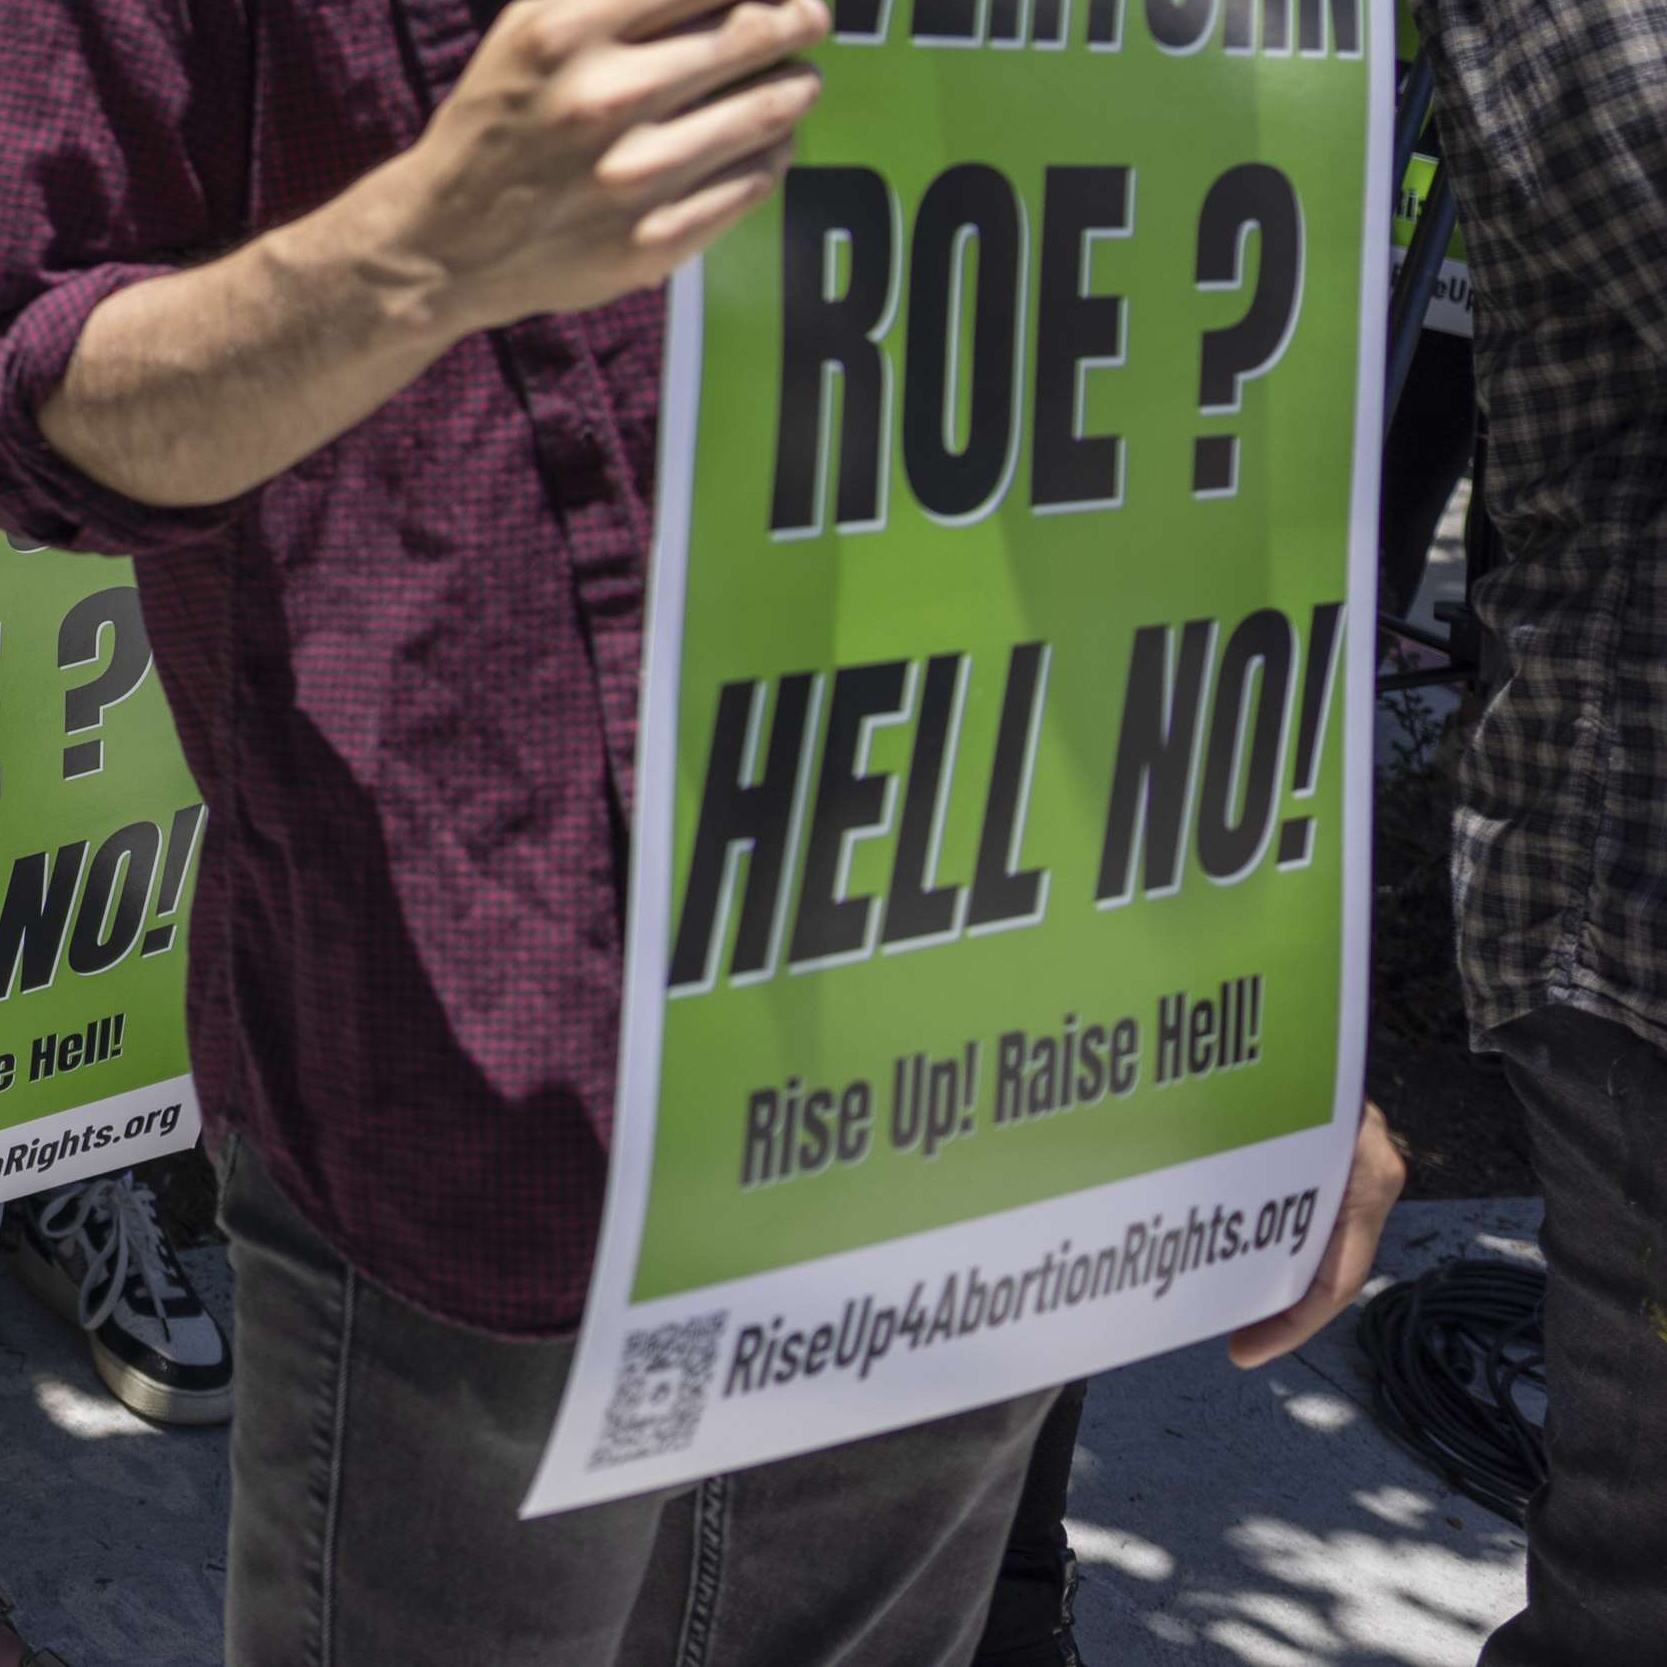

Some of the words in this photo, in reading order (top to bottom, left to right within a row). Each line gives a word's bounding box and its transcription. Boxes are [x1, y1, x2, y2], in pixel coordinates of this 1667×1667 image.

[767, 161, 1139, 538] ROE
[1192, 161, 1307, 500] ?
[57, 585, 154, 782] ?
[667, 642, 1052, 999] HELL
[1094, 601, 1347, 912] NO!
[28, 1014, 126, 1083] Hell!
[737, 1078, 874, 1191] Rise
[891, 1040, 980, 1160] Up!
[993, 1014, 1140, 1127] Raise
[1154, 974, 1264, 1088] Hell!
[723, 1186, 1321, 1400] RiseUp4AbortionRights.org
